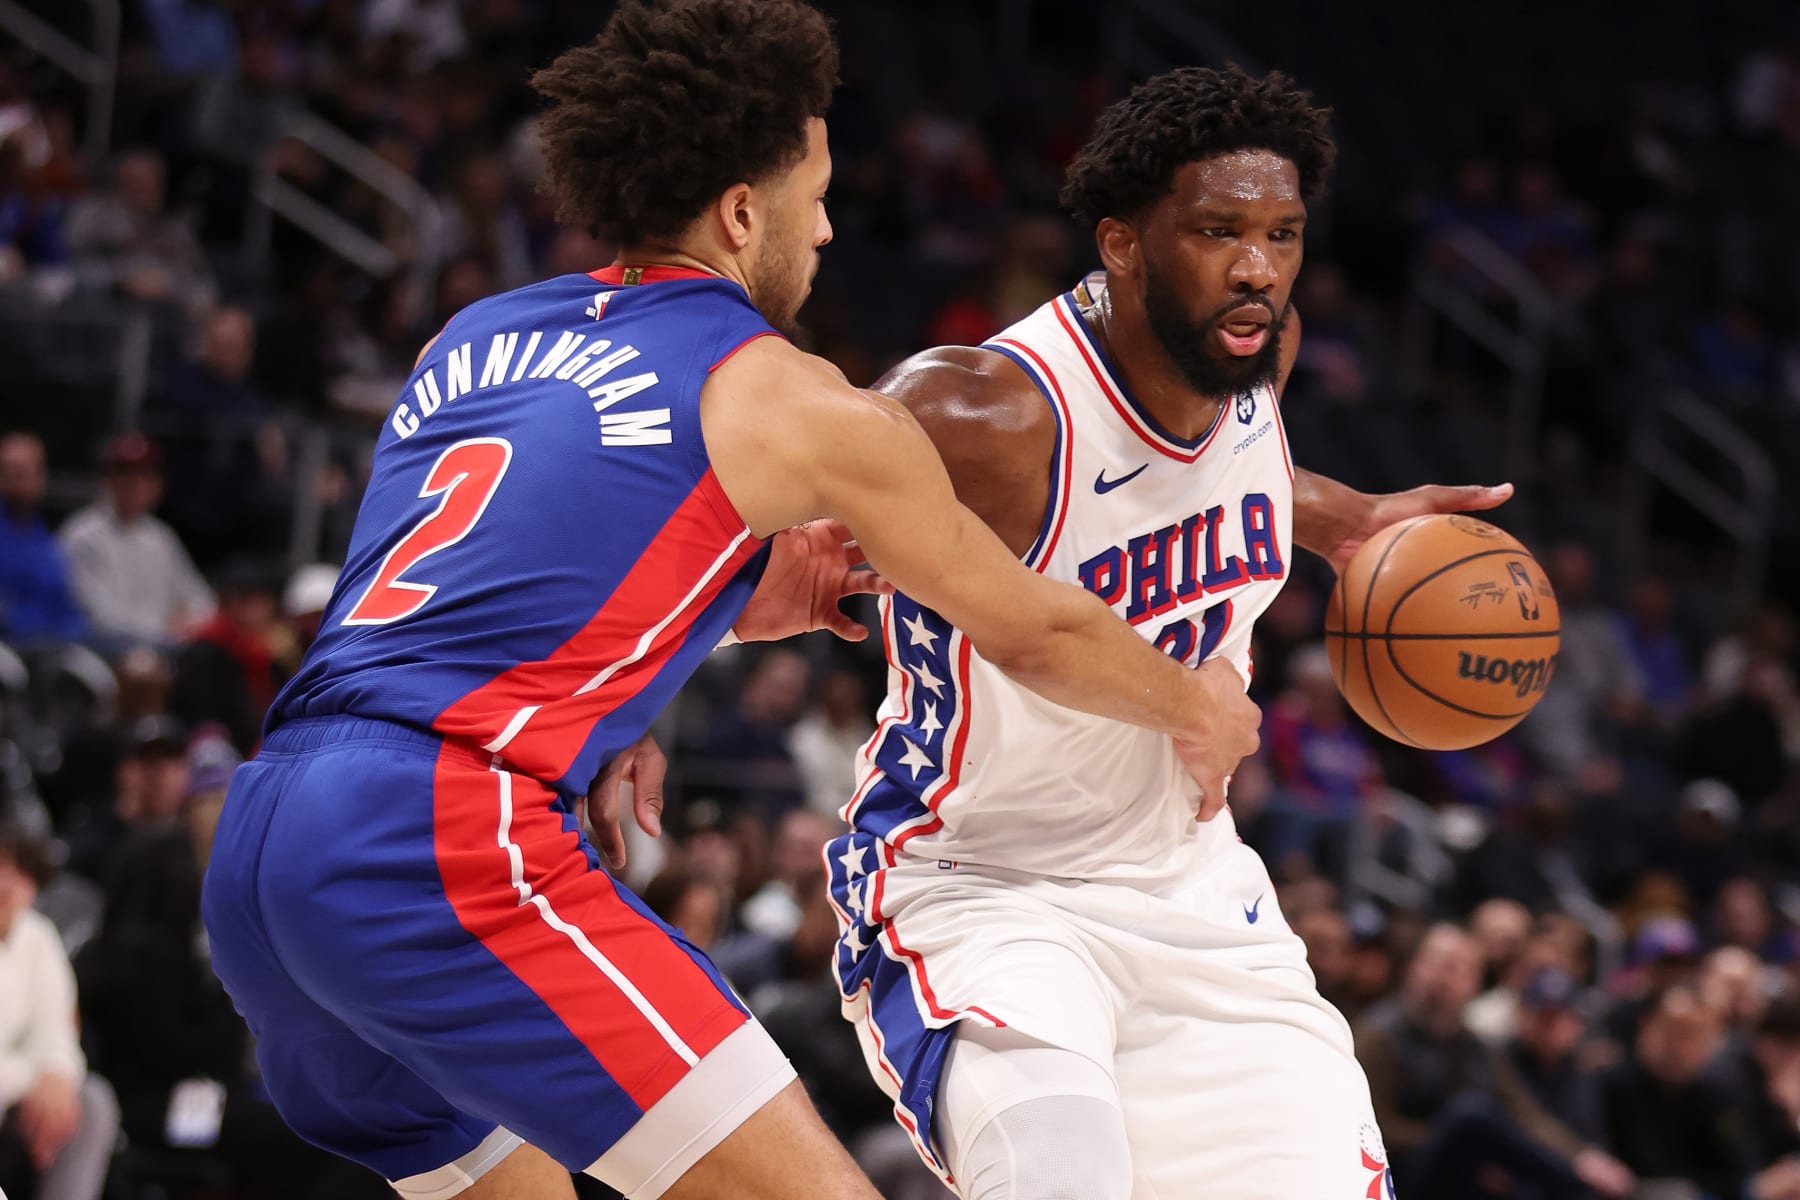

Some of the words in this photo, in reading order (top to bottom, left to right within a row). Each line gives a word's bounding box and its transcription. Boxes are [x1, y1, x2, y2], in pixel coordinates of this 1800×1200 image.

[392, 331, 673, 446] CUNNINGHAM
[1233, 420, 1273, 455] crypto.com
[340, 436, 513, 626] 2
[1078, 493, 1285, 626] PHILA
[1458, 650, 1560, 697] ilson
